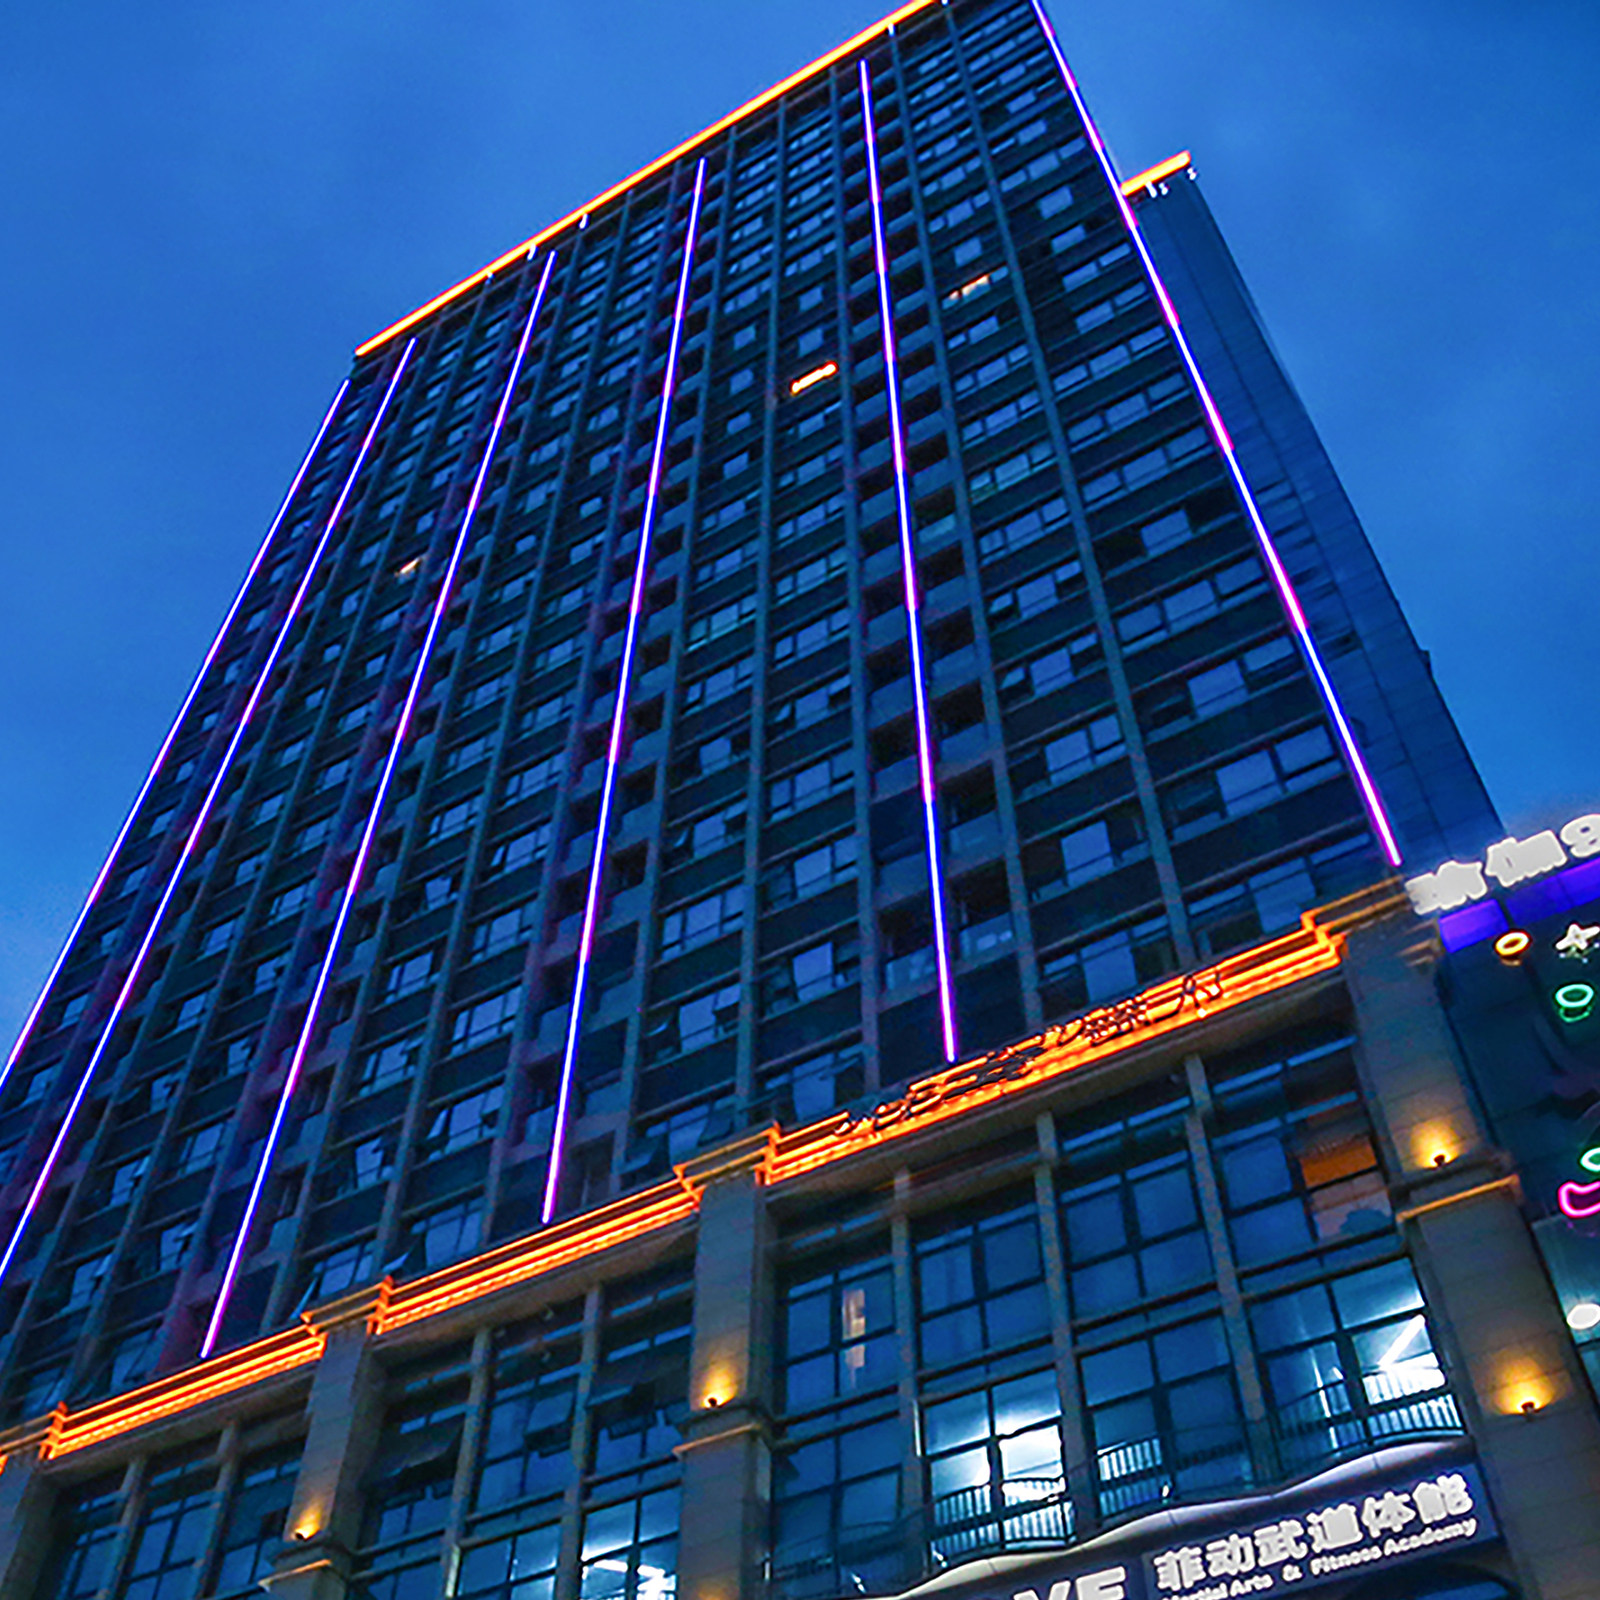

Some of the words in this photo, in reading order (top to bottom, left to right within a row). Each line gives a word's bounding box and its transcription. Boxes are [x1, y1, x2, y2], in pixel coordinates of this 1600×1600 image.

[1229, 1574, 1273, 1597] Arts
[1310, 1545, 1382, 1576] Fitness
[1383, 1517, 1477, 1556] Academy
